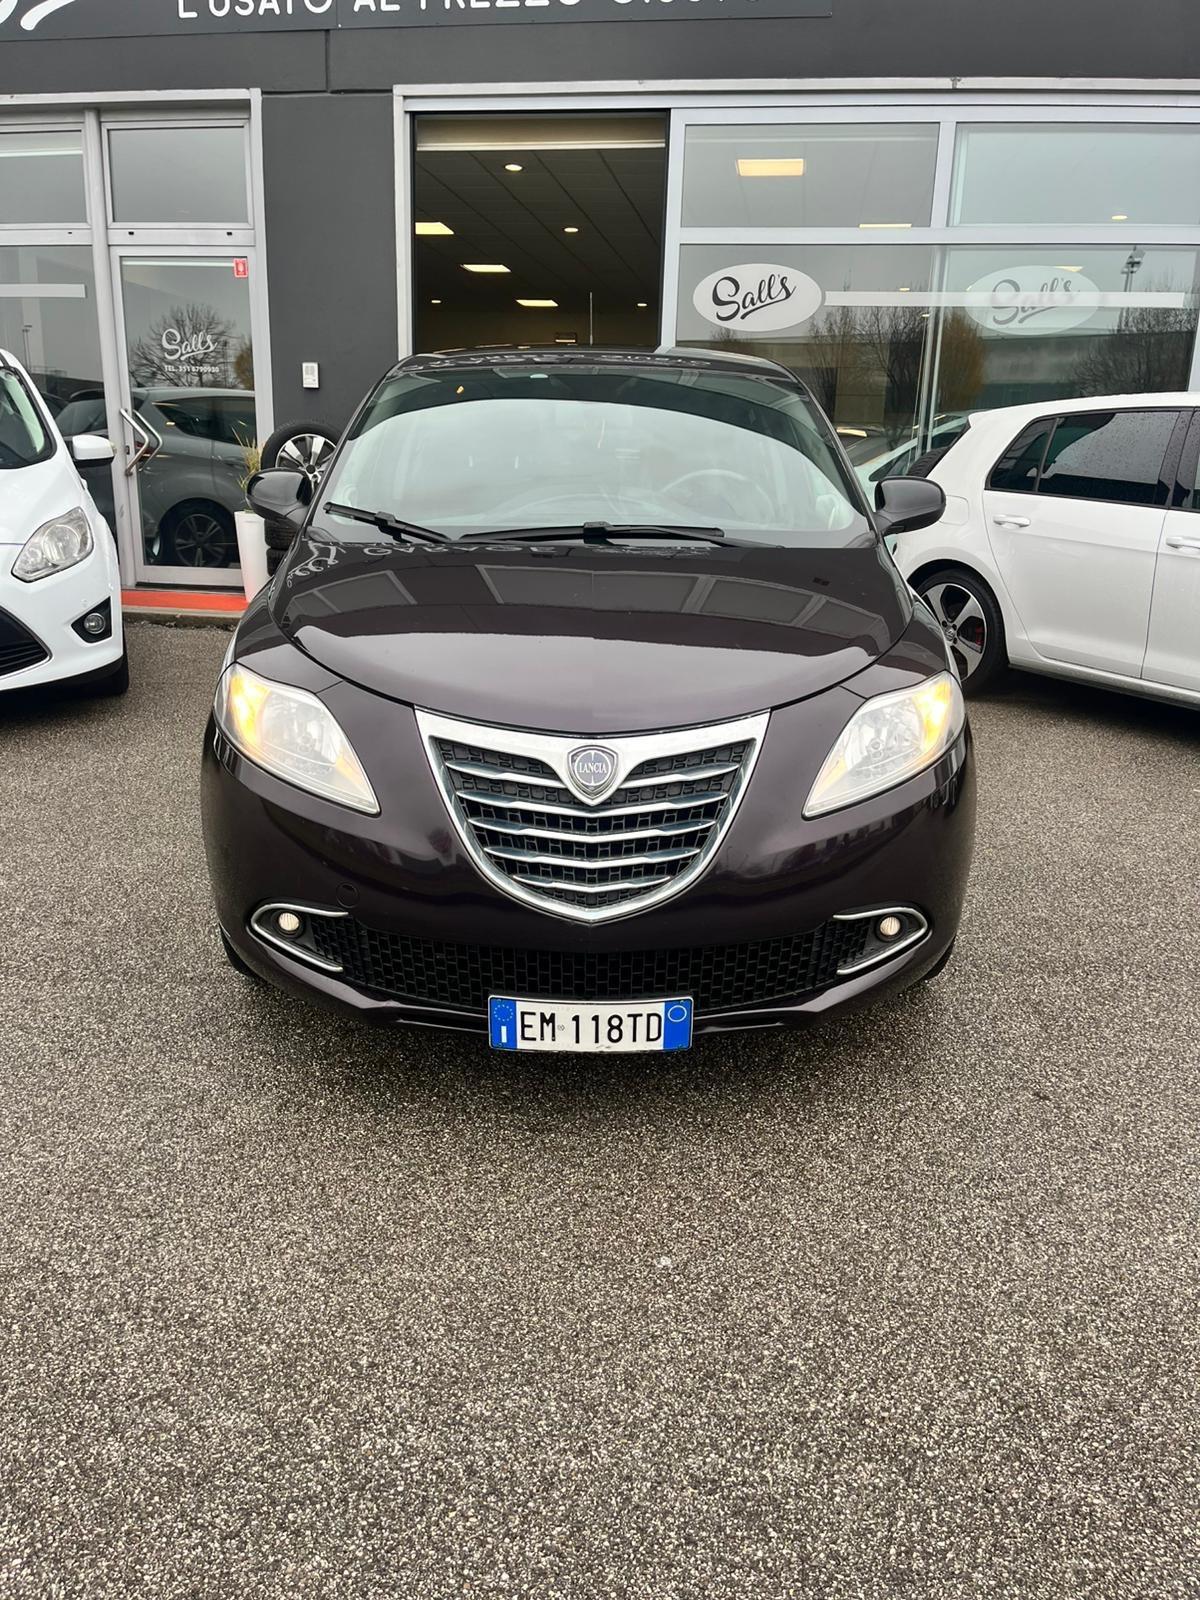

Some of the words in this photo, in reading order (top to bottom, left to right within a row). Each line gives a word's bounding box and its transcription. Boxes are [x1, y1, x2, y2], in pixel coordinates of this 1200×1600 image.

[712, 273, 796, 321] Sall's
[579, 762, 607, 773] LANCIA
[520, 1011, 556, 1042] EM
[571, 1012, 662, 1044] 118TD
